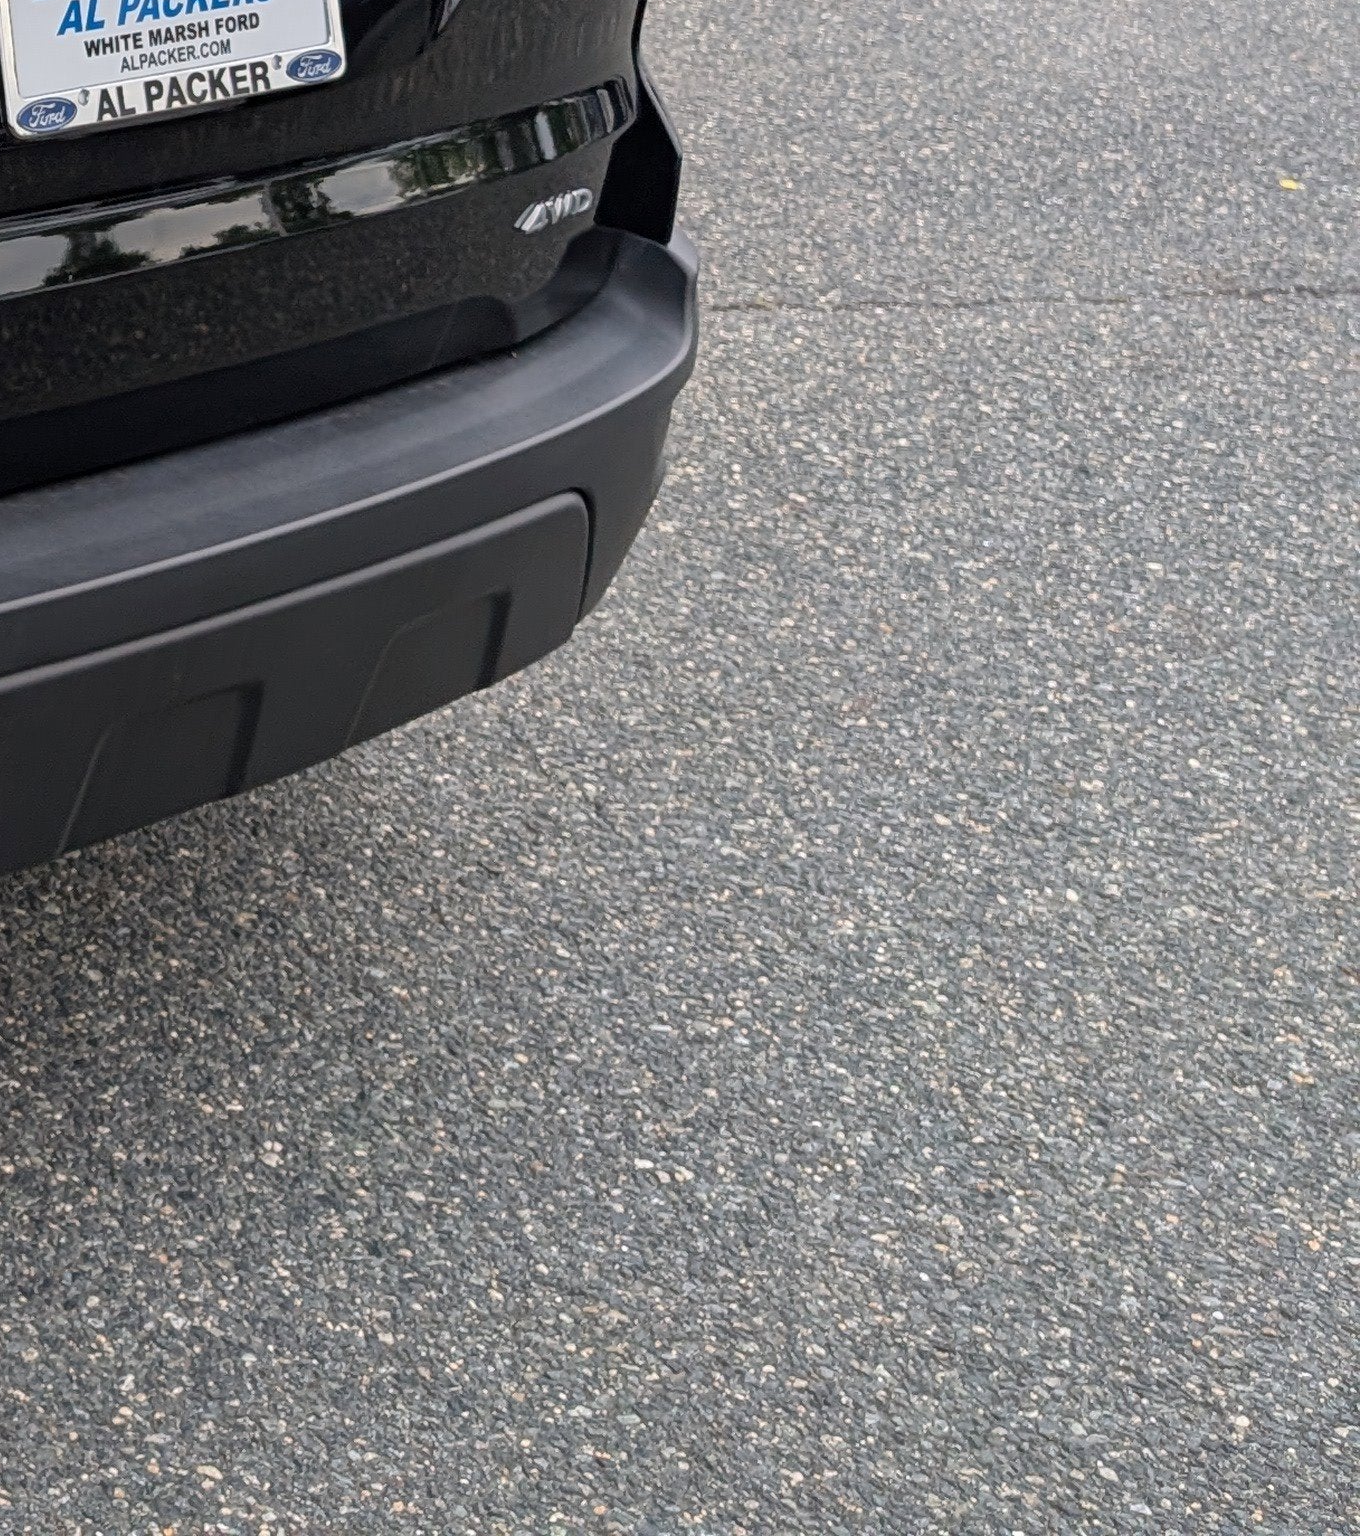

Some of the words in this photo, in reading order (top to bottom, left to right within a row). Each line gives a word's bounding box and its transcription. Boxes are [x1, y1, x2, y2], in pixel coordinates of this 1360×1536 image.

[84, 33, 143, 58] WHITE
[148, 22, 209, 47] MARSH
[215, 12, 260, 35] FORD
[120, 38, 232, 73] ALPACKER.COM
[298, 55, 332, 78] Ford
[96, 85, 136, 121] AL
[144, 61, 271, 111] PACKER
[28, 103, 66, 129] Ford
